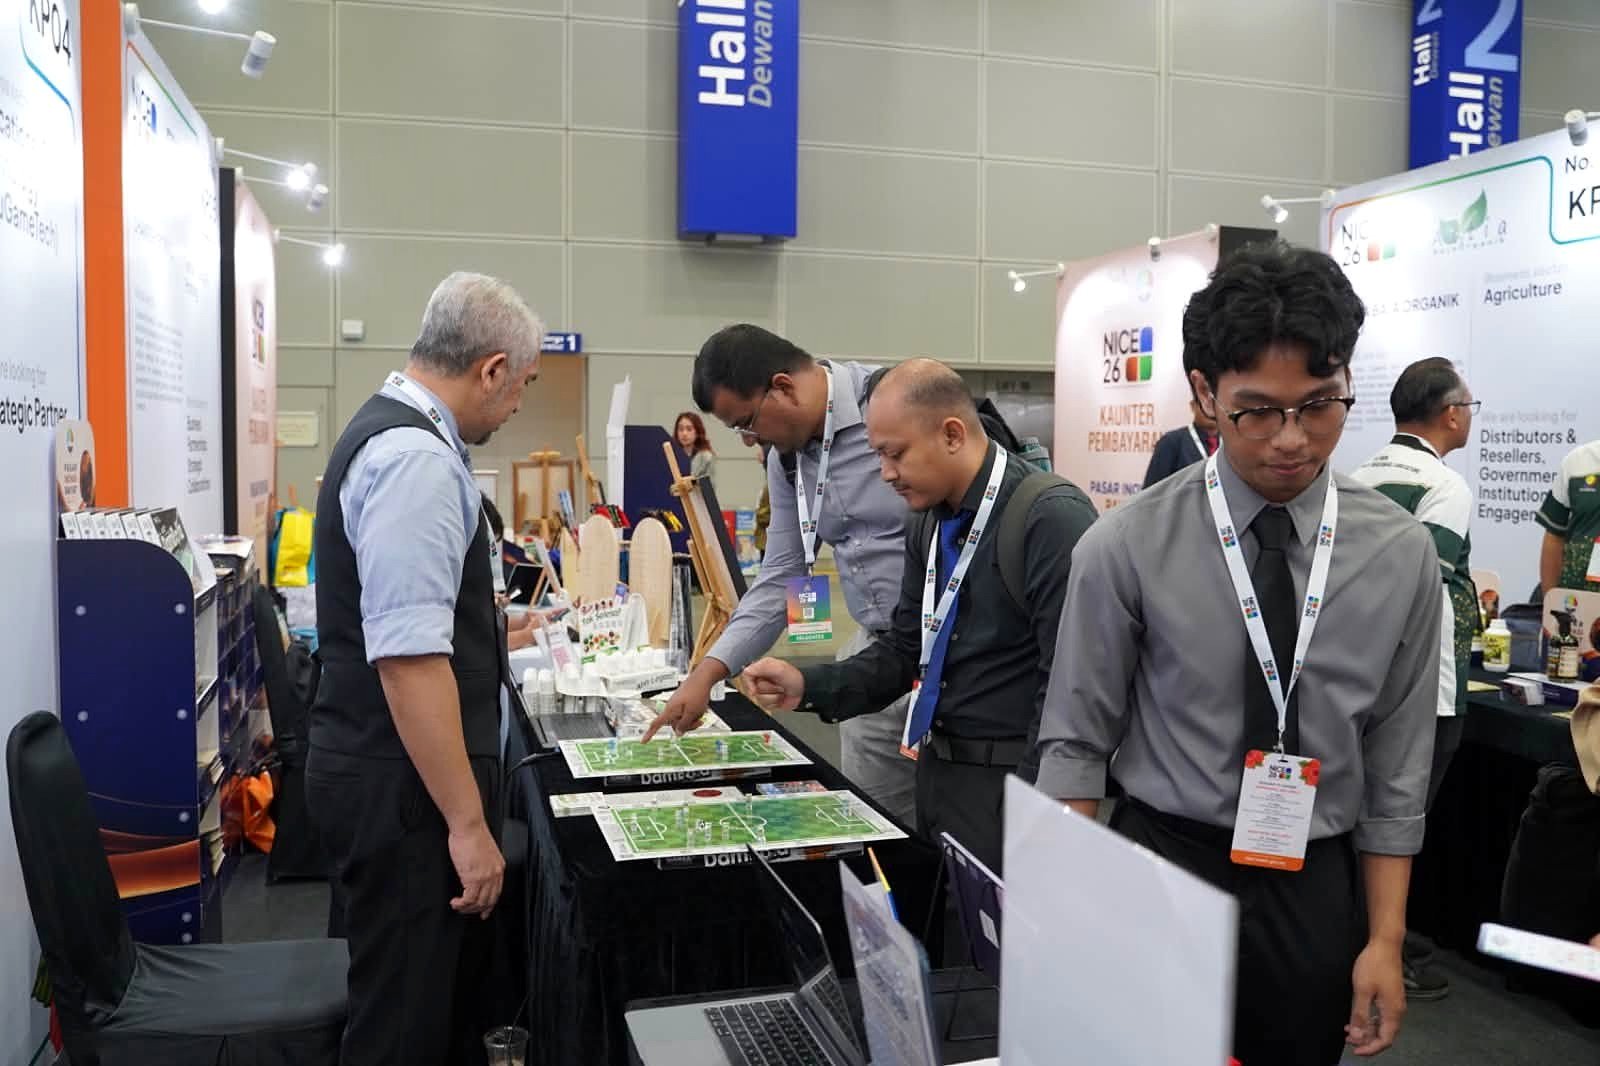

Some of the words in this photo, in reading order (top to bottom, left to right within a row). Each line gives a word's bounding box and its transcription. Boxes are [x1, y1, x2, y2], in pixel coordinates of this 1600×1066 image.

[695, 0, 746, 107] Hall
[747, 0, 773, 109] Dewan
[1412, 33, 1432, 87] Hall
[1483, 281, 1563, 307] Agriculture
[1103, 327, 1140, 358] NICE
[1103, 356, 1121, 384] 26
[1099, 403, 1154, 427] KAUNTER
[1087, 430, 1164, 454] PEMBAYARA
[1480, 428, 1563, 445] Distributors
[1566, 427, 1577, 445] &
[1089, 481, 1120, 494] PASAR
